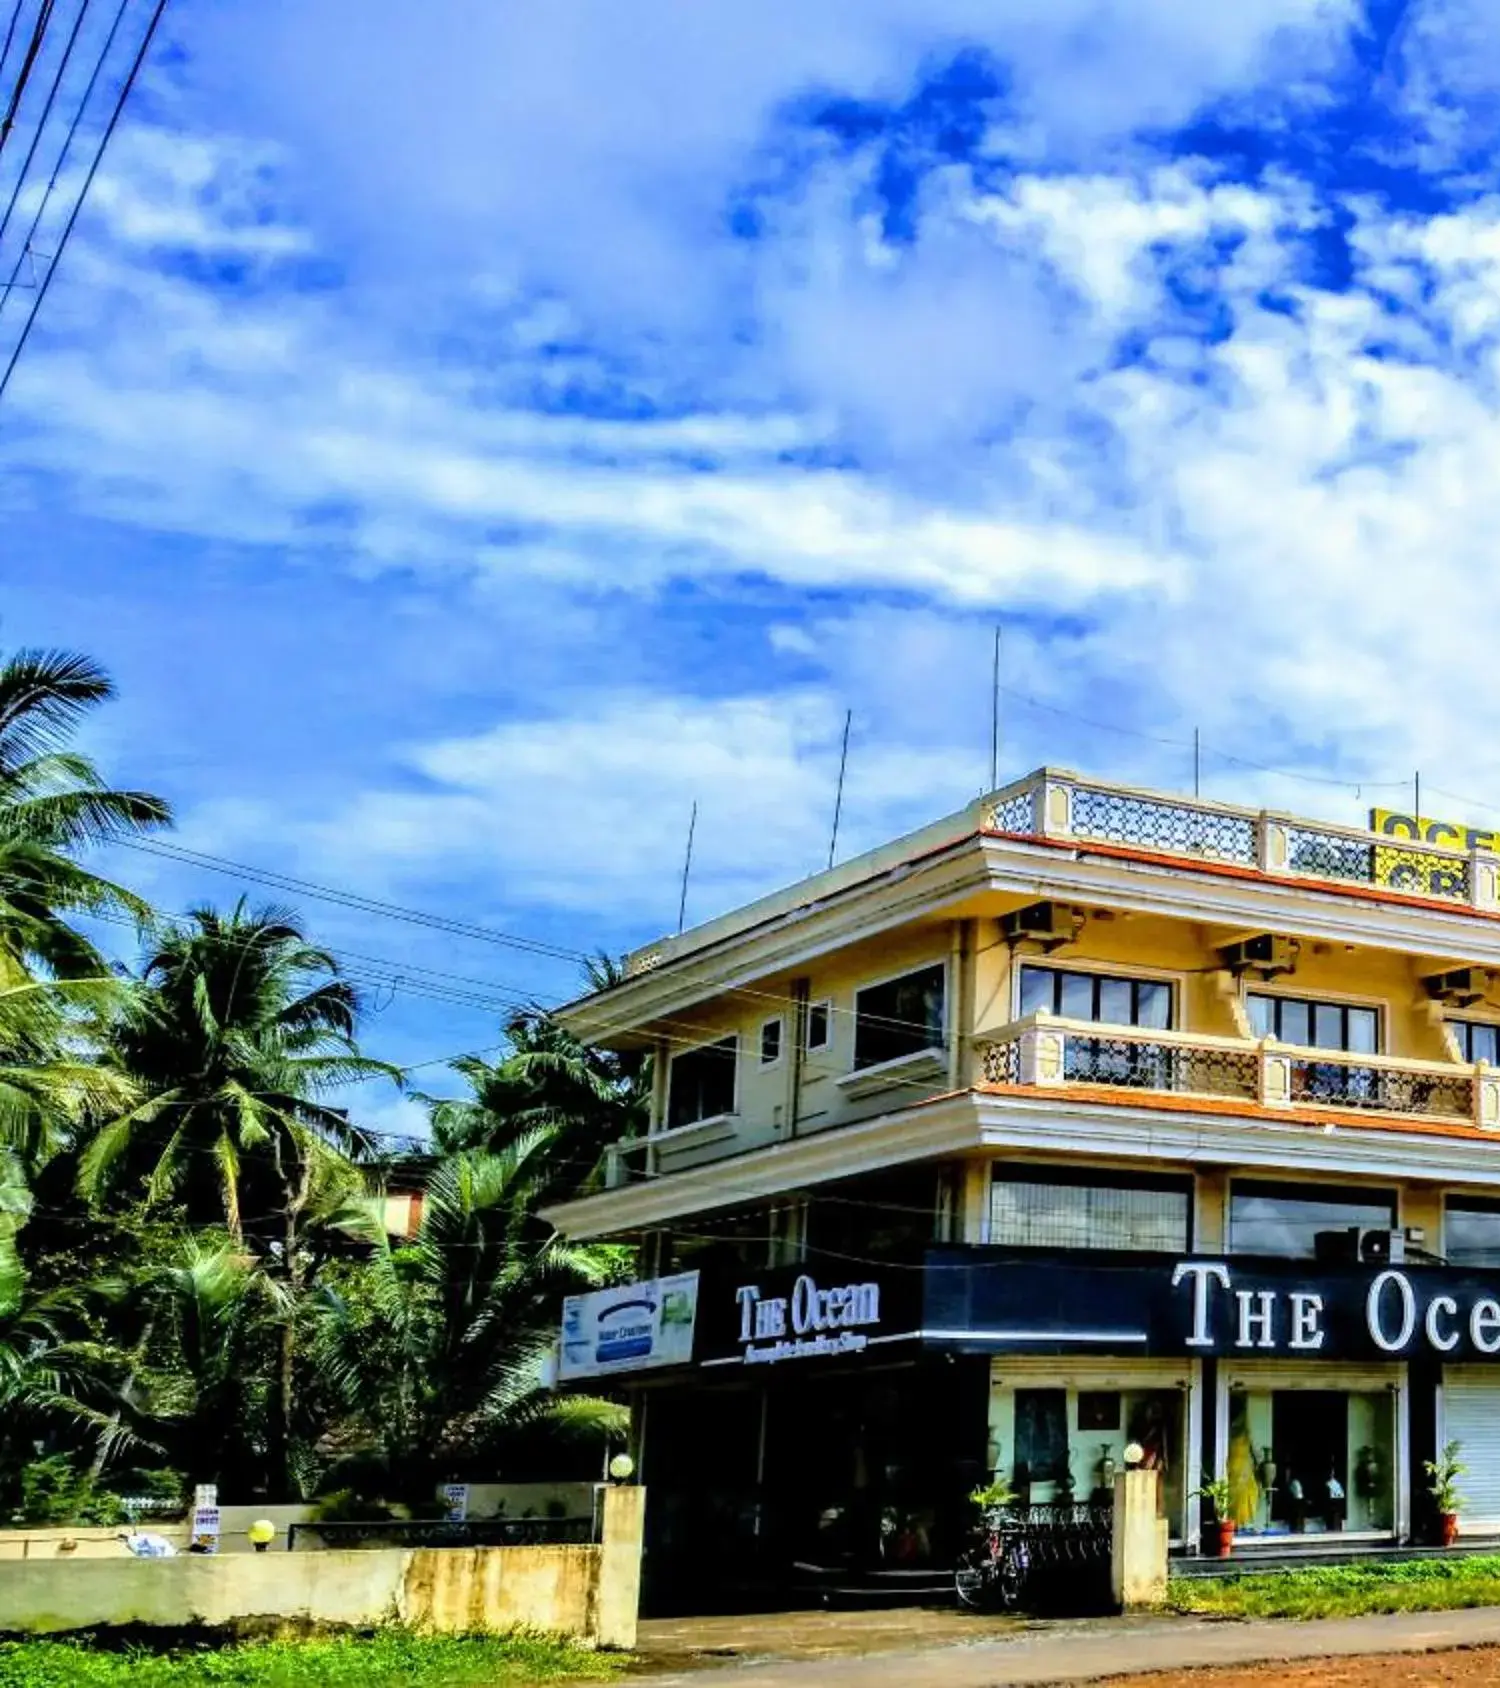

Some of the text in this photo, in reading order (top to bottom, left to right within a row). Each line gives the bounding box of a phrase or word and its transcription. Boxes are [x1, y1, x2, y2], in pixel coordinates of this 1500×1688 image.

[736, 1274, 881, 1342] THE Ocean
[1171, 1262, 1326, 1350] THE
